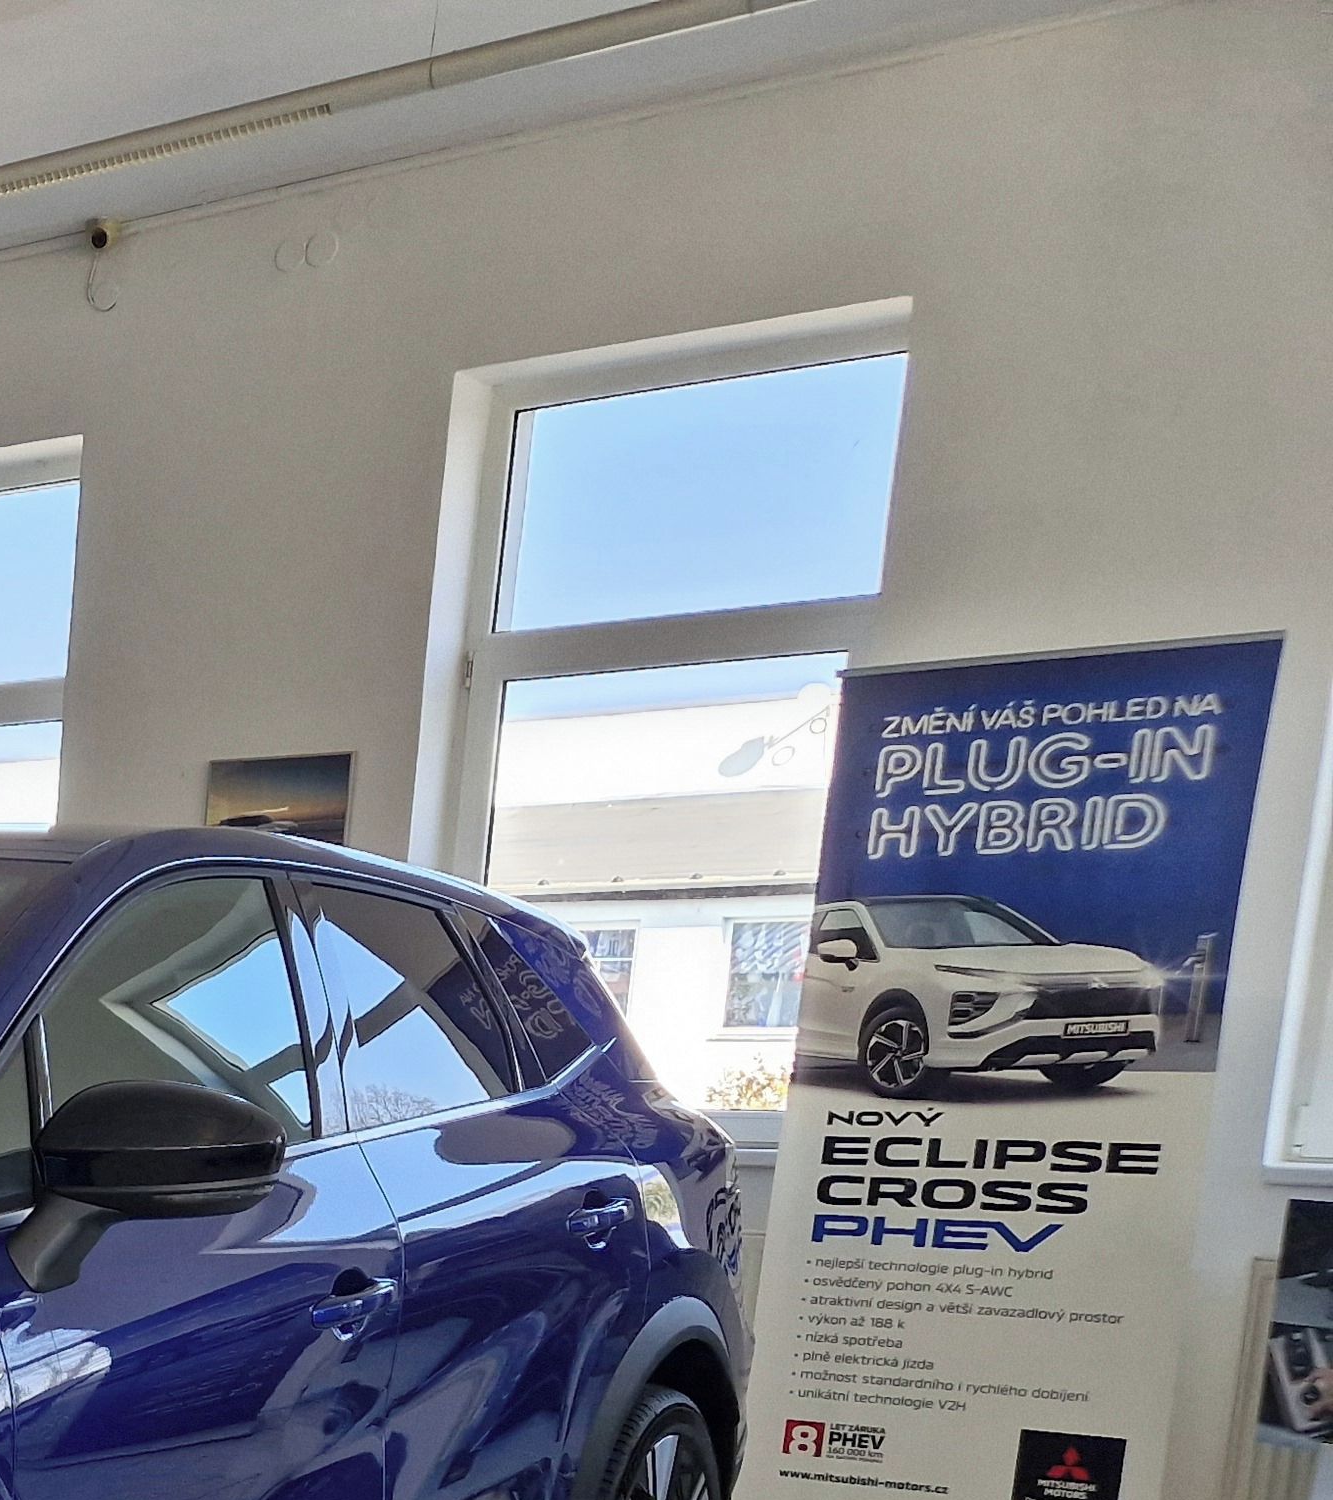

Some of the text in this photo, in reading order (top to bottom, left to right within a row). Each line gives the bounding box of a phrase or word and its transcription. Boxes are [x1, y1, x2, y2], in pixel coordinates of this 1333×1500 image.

[881, 692, 1222, 739] ZMĚNÍ VÁŠ POHLED NA
[874, 724, 1217, 798] PLUG-IN
[867, 793, 1167, 860] HYBRID
[1066, 1021, 1126, 1035] MITSUBISHI
[826, 1107, 944, 1128] NOVÝ
[820, 1135, 1163, 1176] ECLIPSE
[815, 1175, 1089, 1214] CROSS
[810, 1214, 1064, 1253] PHEV
[815, 1257, 1054, 1281] nejlepší technologie plug-in hybrid
[812, 1276, 883, 1291] osvědčený
[886, 1280, 931, 1292] pohon
[965, 1284, 1014, 1298] S-AWC
[808, 1313, 906, 1330] výkon až 188 k
[809, 1295, 1125, 1325] atraktivní design a větší zavazadlový prostor
[805, 1331, 903, 1349] nízká spotřeba
[802, 1351, 935, 1370] plně elektrická jízda
[800, 1369, 858, 1384] možnost
[861, 1374, 954, 1392] standardního
[958, 1383, 962, 1391] i
[966, 1383, 1028, 1397] rychlého
[797, 1388, 967, 1412] unikátní technologie V2H
[789, 1424, 819, 1457] 8
[826, 1446, 884, 1458] 160 000 km
[828, 1431, 886, 1450] PHEV
[779, 1467, 950, 1495] www.mitsubishi-motors.cz
